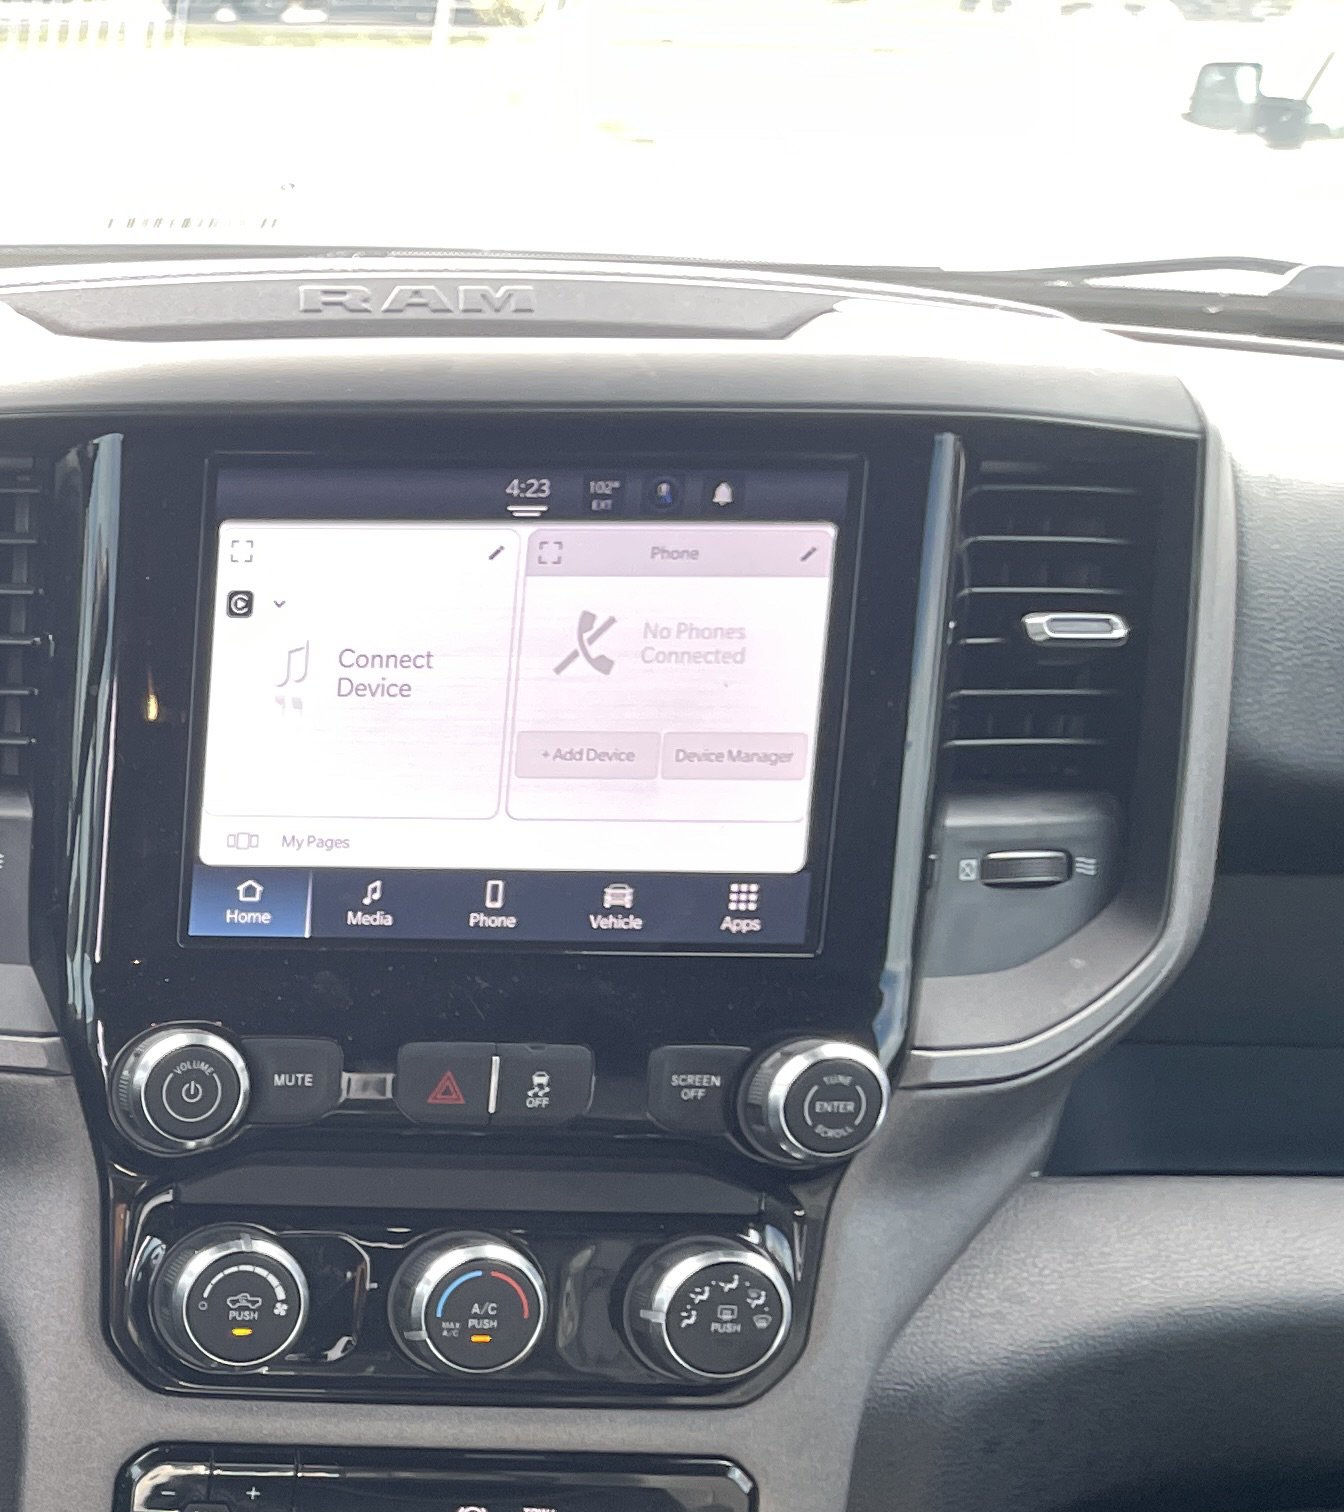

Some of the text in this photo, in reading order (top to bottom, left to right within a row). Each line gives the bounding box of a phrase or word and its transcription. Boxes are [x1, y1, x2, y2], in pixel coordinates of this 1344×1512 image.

[297, 283, 535, 314] RAM
[505, 477, 551, 499] 4:23
[650, 545, 699, 562] Phone
[643, 622, 746, 641] No Phones
[337, 648, 434, 671] Connect
[641, 646, 746, 666] Connected
[336, 677, 412, 699] Device
[552, 748, 584, 763] Add
[587, 747, 635, 763] Device
[675, 748, 794, 768] Device Manager
[281, 835, 350, 852] My Pages
[226, 909, 272, 926] Home
[346, 911, 393, 927] Media
[468, 912, 516, 929] Phone
[589, 914, 643, 931] Vehicle
[720, 916, 761, 934] Apps
[173, 1060, 215, 1077] VOLUME
[273, 1073, 313, 1087] MUTE
[671, 1074, 722, 1088] SCREEN
[525, 1096, 550, 1109] OFF
[681, 1087, 707, 1101] OFF
[815, 1101, 855, 1113] ENTER
[814, 1124, 854, 1139] SCROLL
[228, 1309, 258, 1321] PUSH
[471, 1303, 498, 1315] A/C
[468, 1319, 498, 1330] PUSH
[711, 1321, 741, 1334] PUSH
